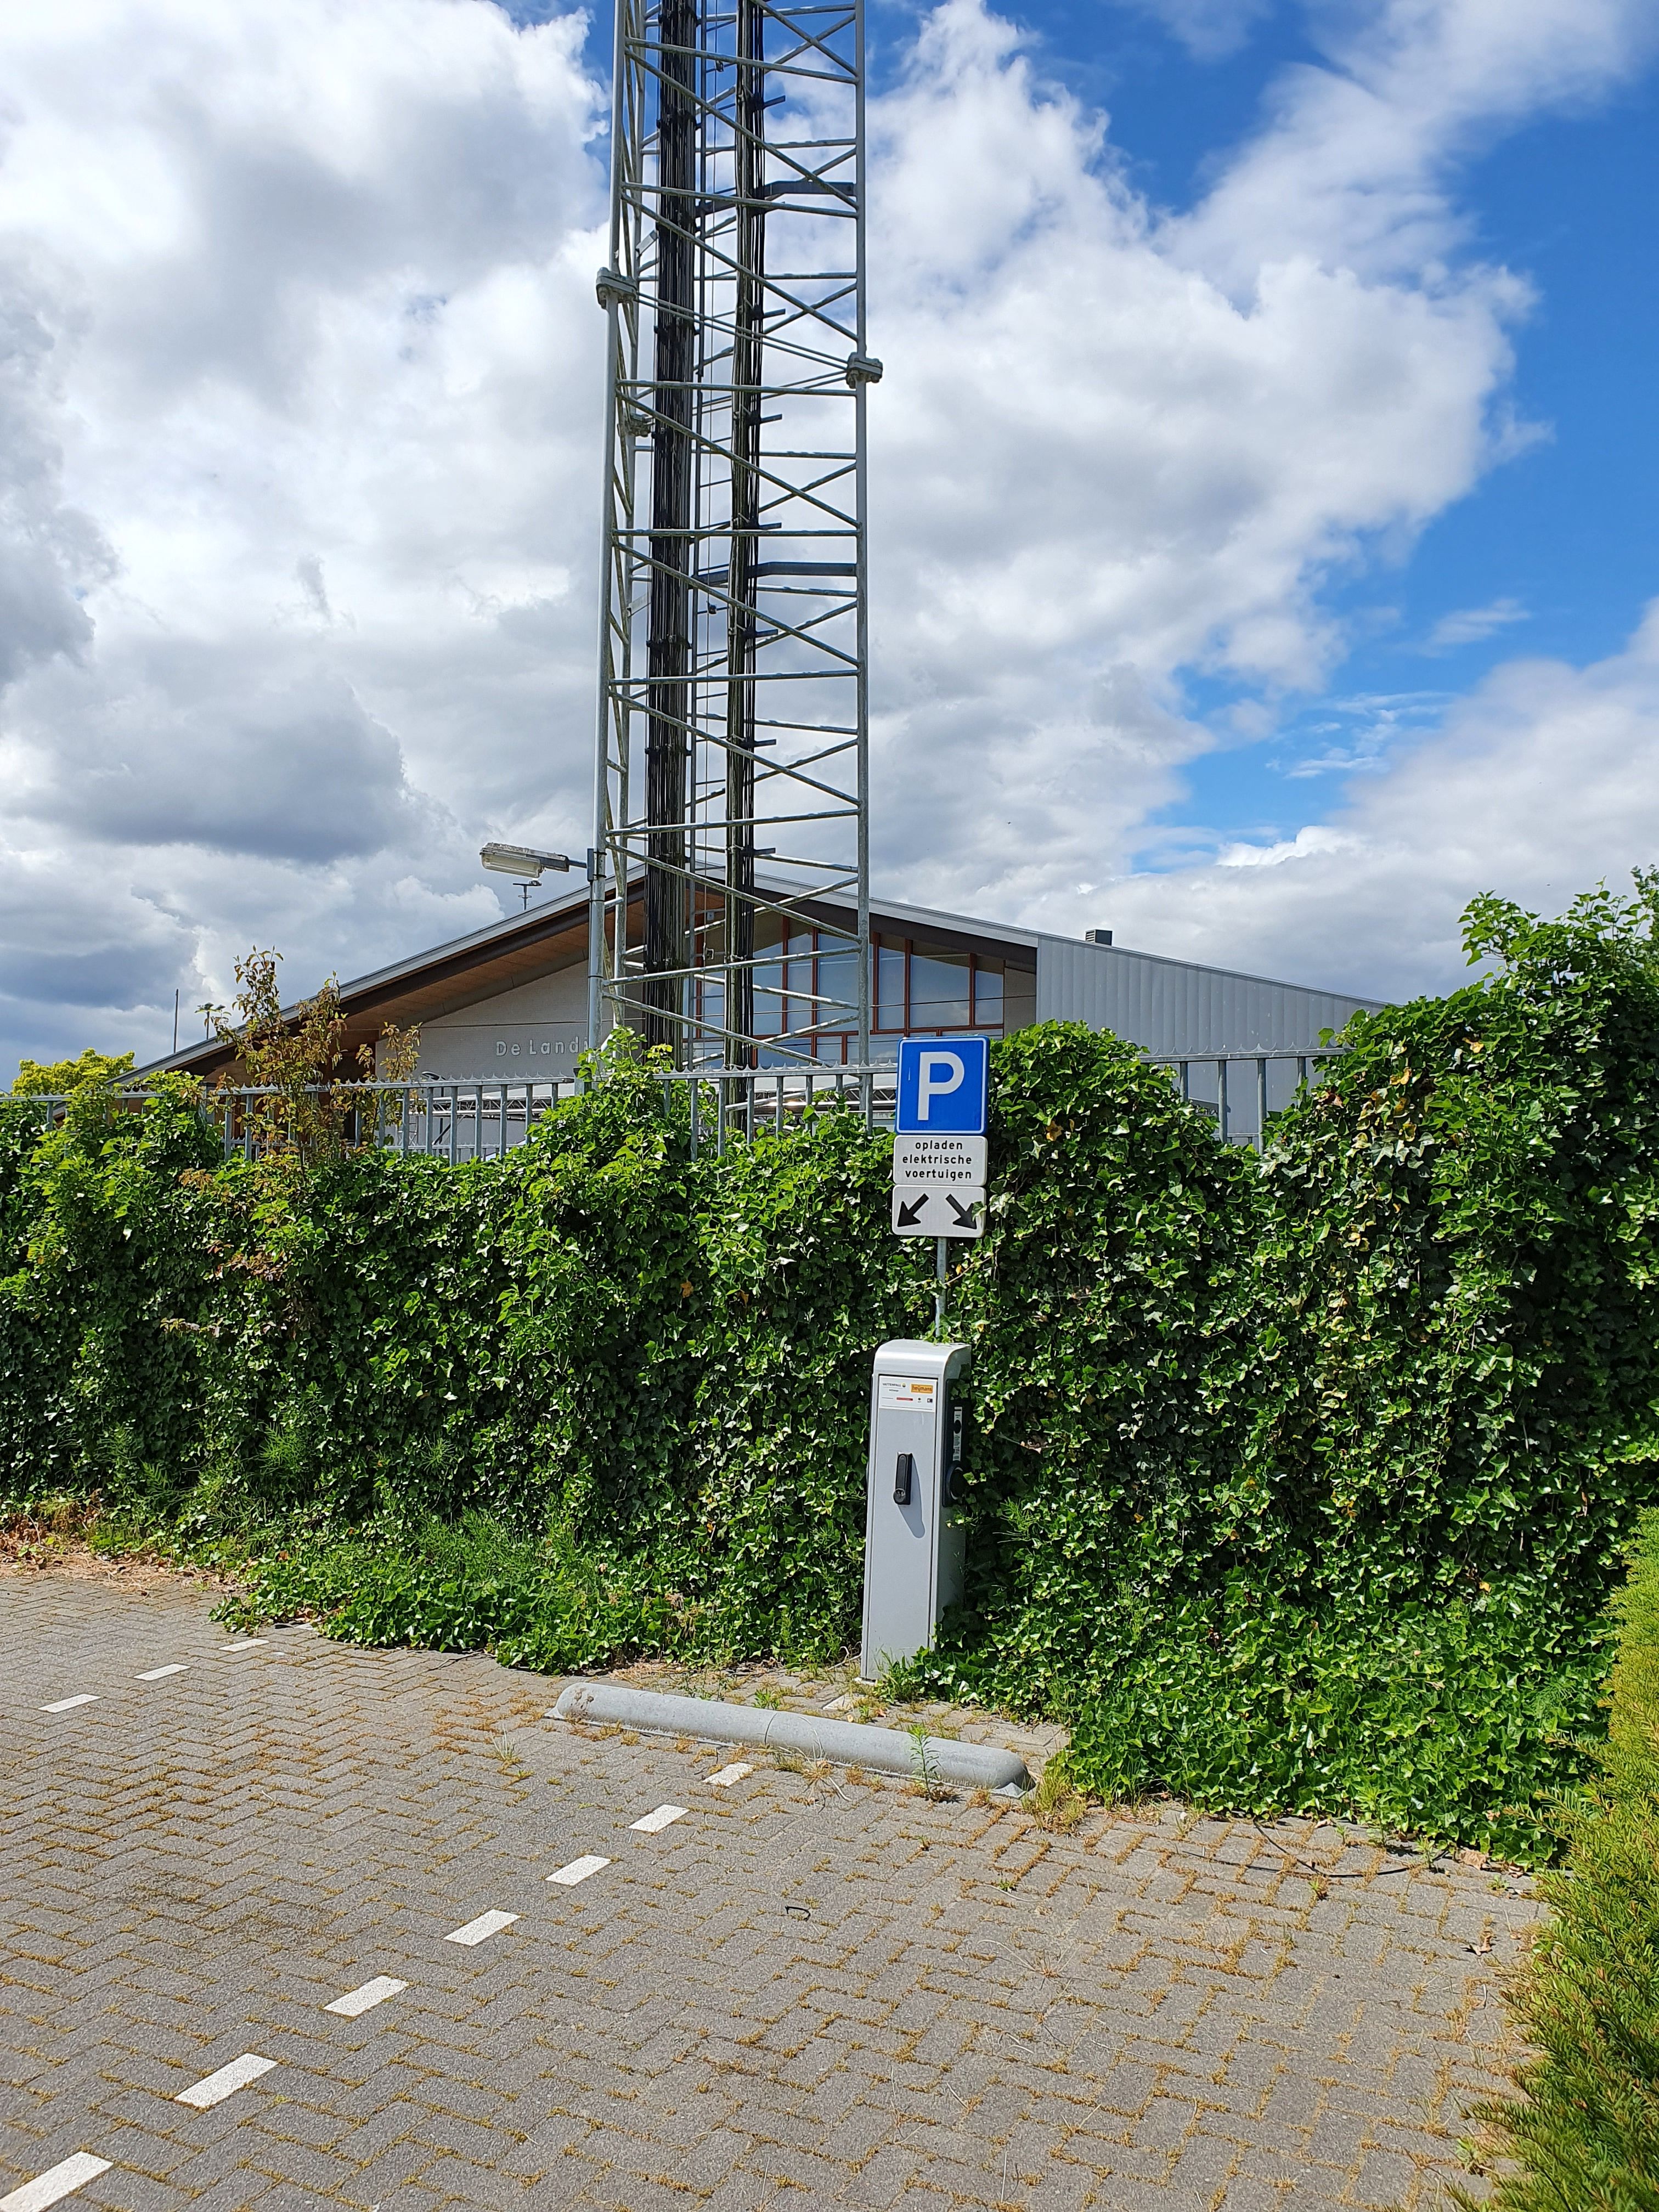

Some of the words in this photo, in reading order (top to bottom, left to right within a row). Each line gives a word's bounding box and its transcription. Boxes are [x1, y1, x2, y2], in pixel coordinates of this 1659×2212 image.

[496, 1041, 521, 1056] De
[917, 1051, 965, 1121] P
[915, 1140, 963, 1152] opladen
[902, 1154, 972, 1164] elektrische
[905, 1169, 972, 1182] voertuigen
